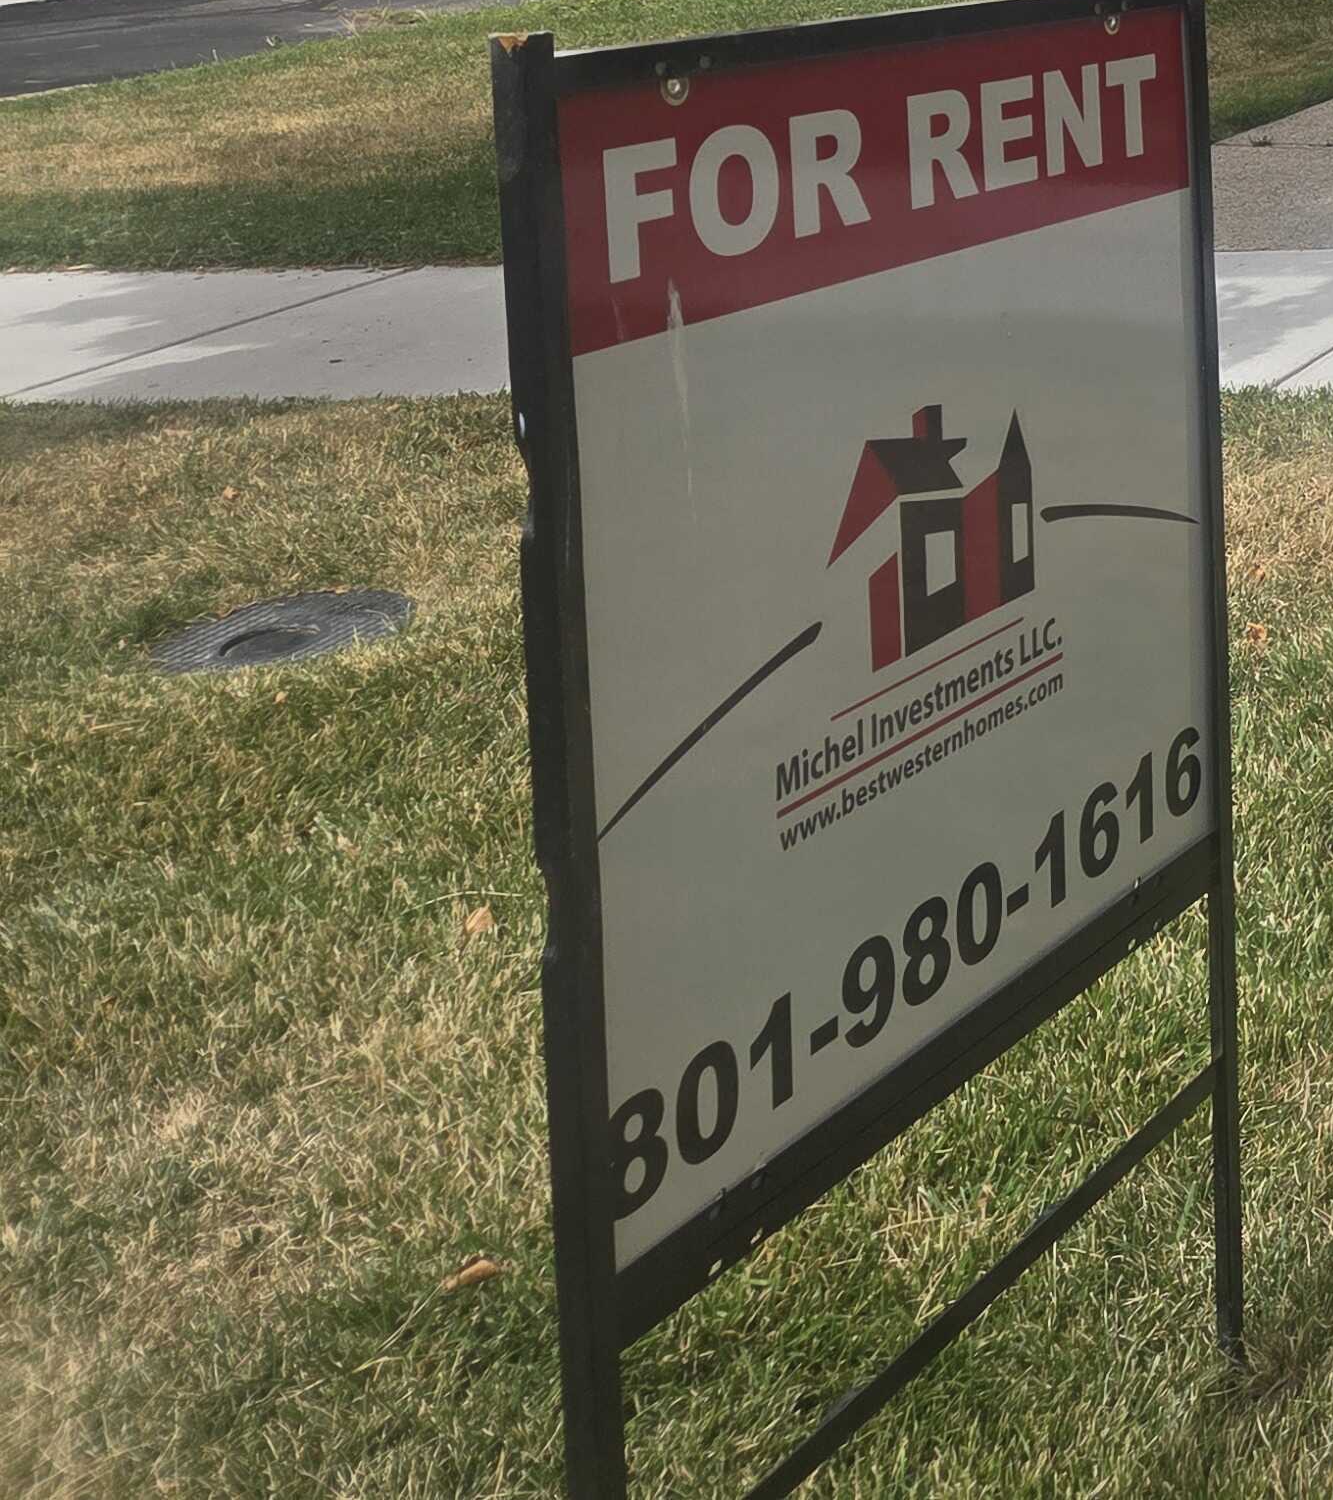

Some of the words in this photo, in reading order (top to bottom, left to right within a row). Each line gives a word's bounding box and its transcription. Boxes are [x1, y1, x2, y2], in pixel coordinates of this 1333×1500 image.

[602, 108, 871, 285] FOR
[907, 53, 1157, 211] RENT
[775, 718, 864, 801] Michel
[870, 648, 1015, 748] Investments
[1018, 617, 1063, 667] LLC.
[779, 672, 1064, 851] www.bestwesternhomes.com
[607, 726, 1202, 1221] 801-980-1616
